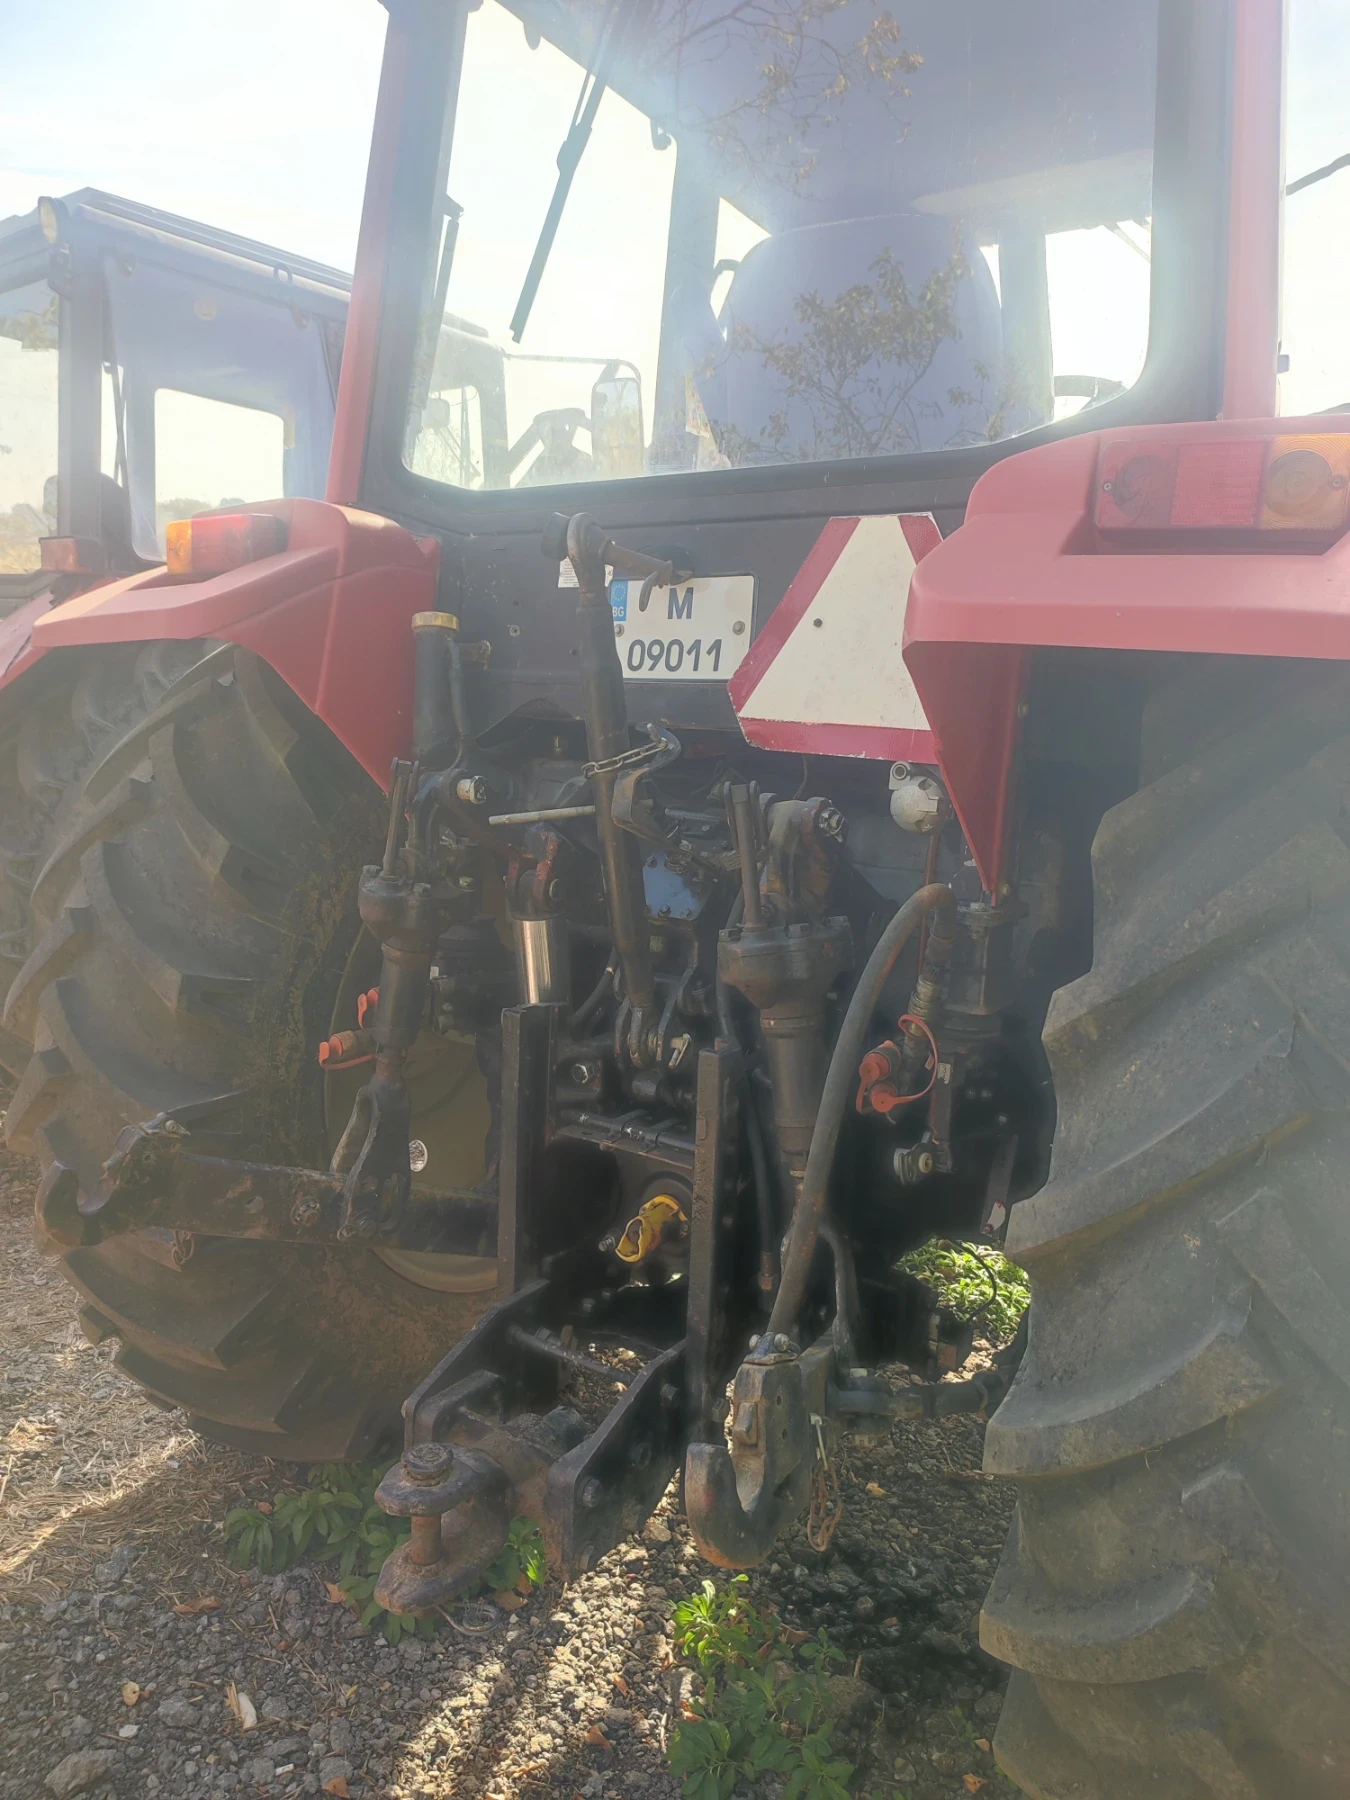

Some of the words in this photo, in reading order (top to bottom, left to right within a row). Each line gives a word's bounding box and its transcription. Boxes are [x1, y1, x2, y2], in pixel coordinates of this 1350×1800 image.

[612, 606, 625, 618] BG
[667, 587, 694, 619] M
[627, 638, 722, 672] 09011
